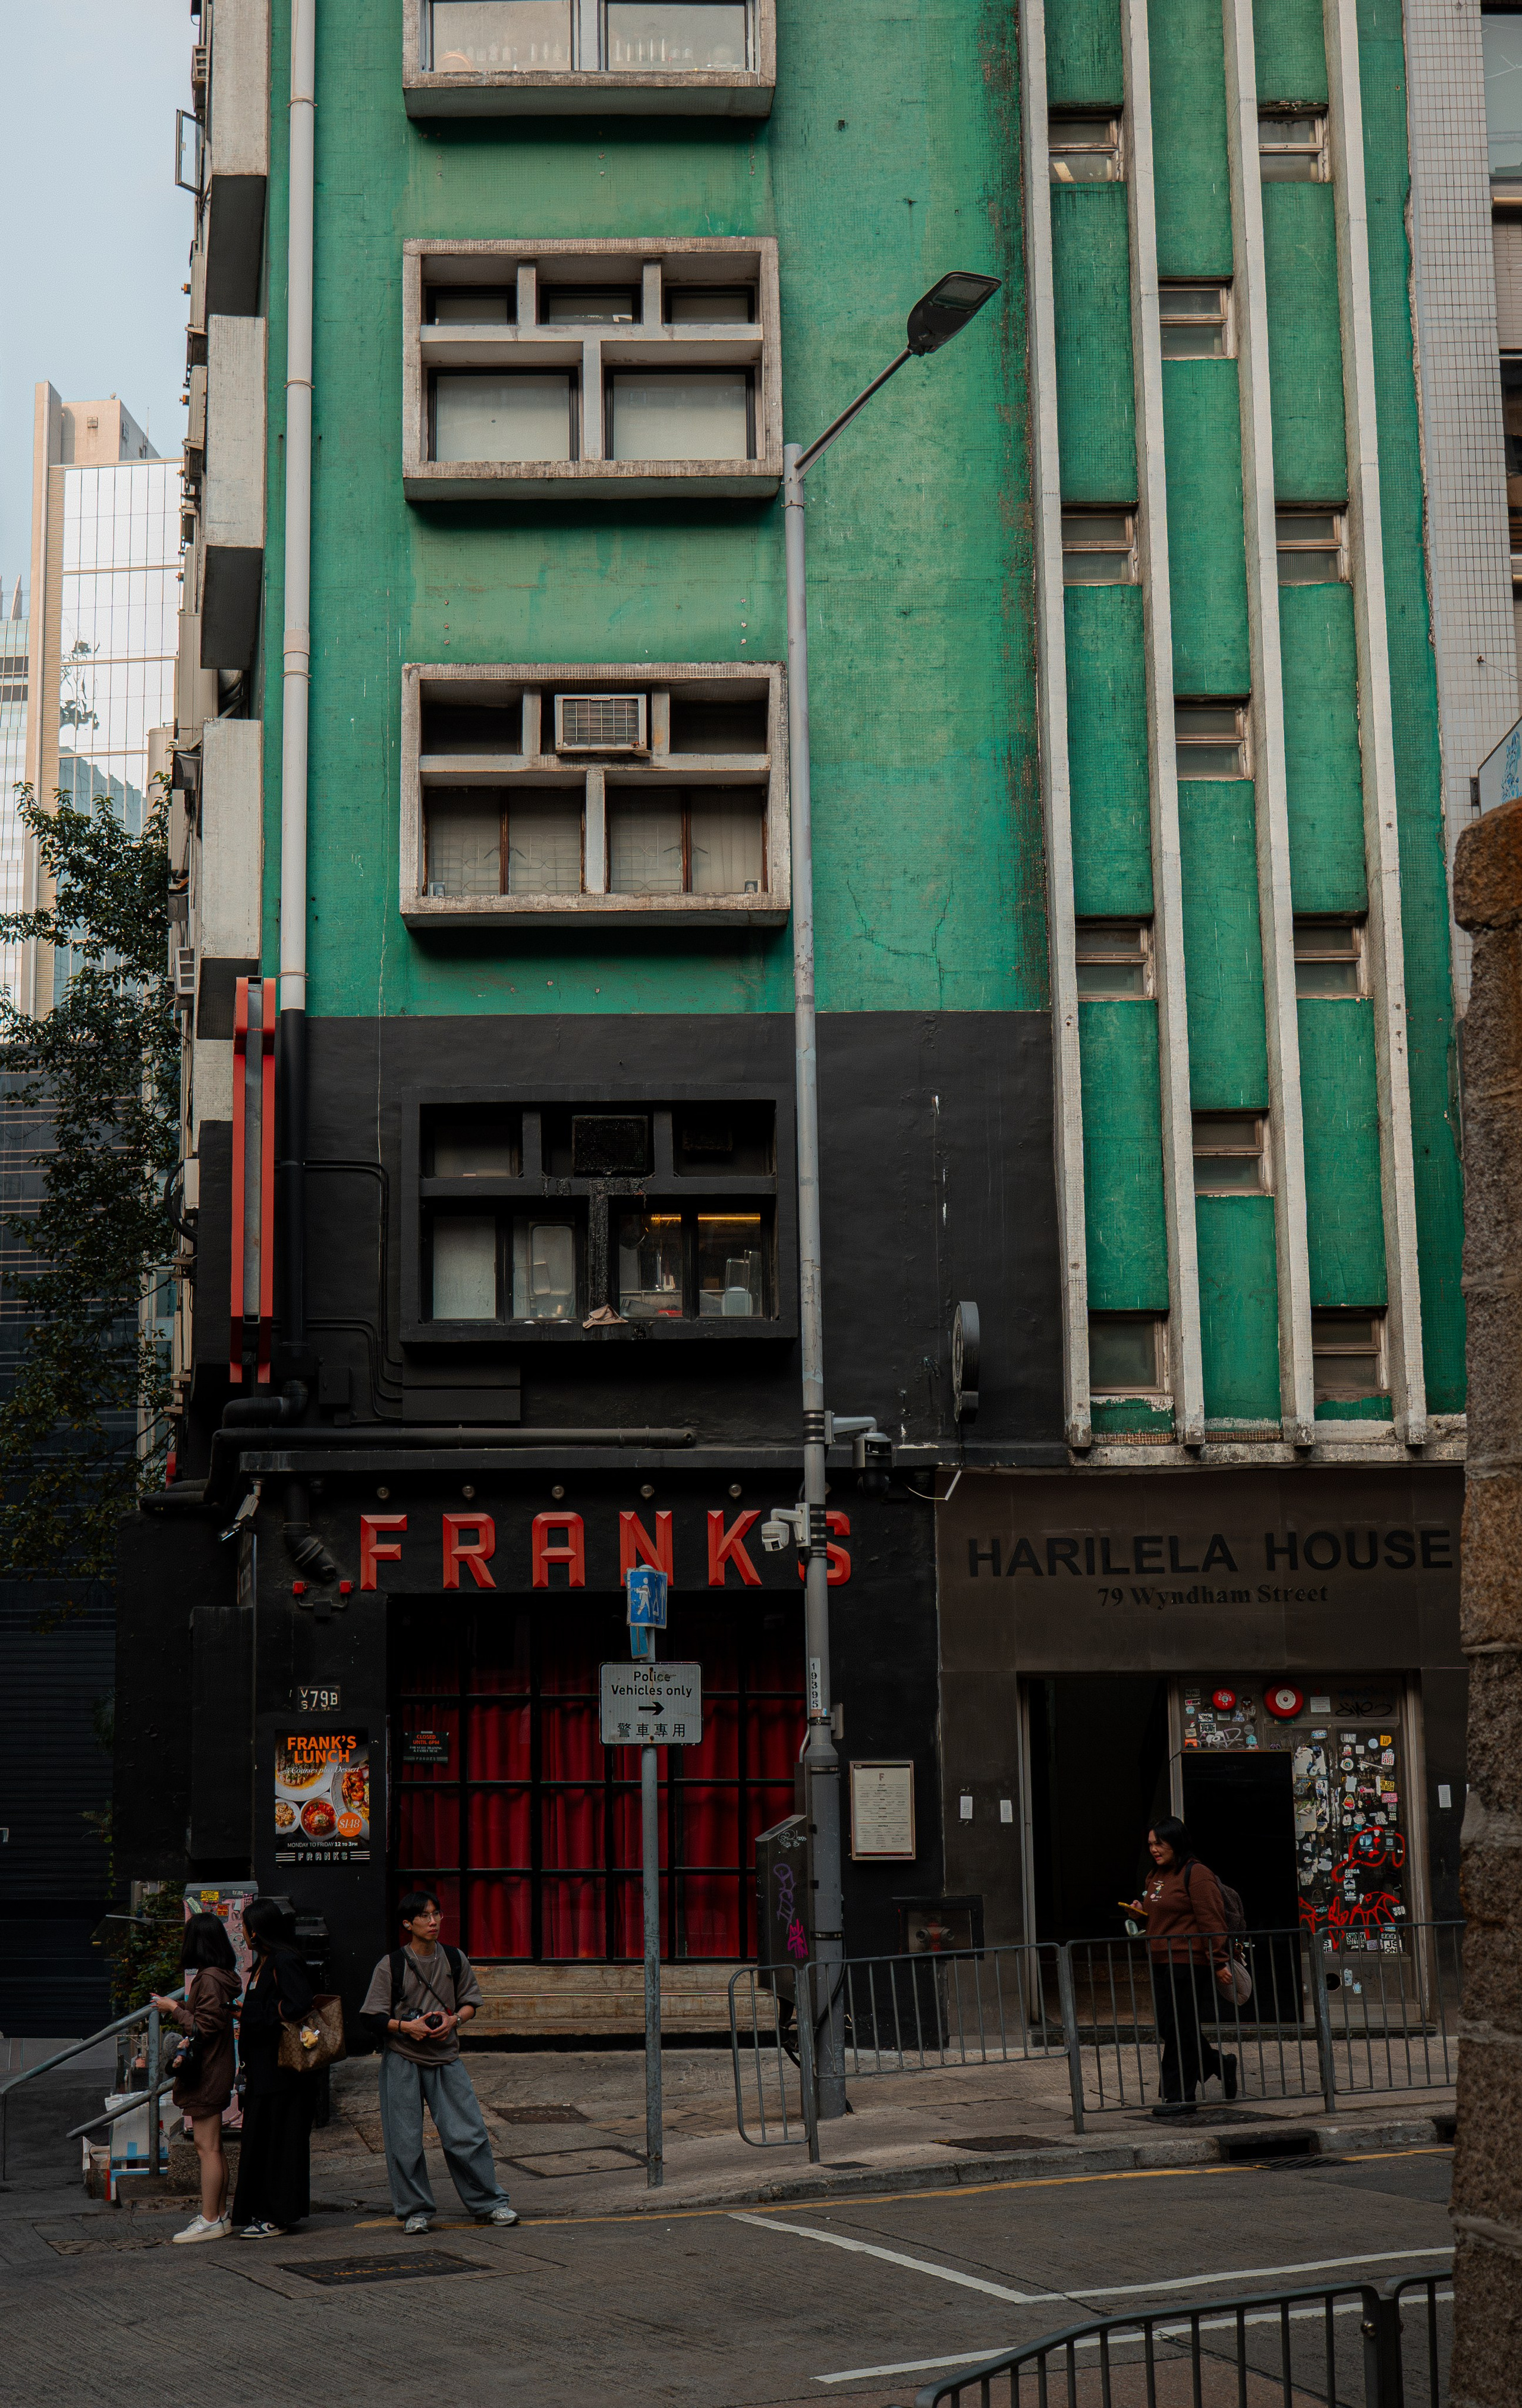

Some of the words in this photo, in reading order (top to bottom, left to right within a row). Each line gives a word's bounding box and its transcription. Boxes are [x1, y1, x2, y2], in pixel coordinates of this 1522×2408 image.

[360, 1511, 851, 1590] FRANKS
[968, 1533, 1238, 1577] HARILELA
[1265, 1529, 1453, 1571] HOUSE
[1098, 1588, 1124, 1607] 79
[1130, 1585, 1251, 1609] Wyndham
[1257, 1584, 1329, 1604] Street
[634, 1671, 671, 1682] Police
[611, 1684, 662, 1695] Vehicles
[666, 1685, 692, 1697] only
[617, 1722, 685, 1738] 警車專用
[287, 1735, 357, 1750] FRANK'S
[294, 1749, 350, 1764] LUNCH
[291, 1766, 318, 1774] Courses
[318, 1766, 334, 1776] plus
[338, 1818, 361, 1829] $148
[298, 1851, 348, 1861] FRANKS
